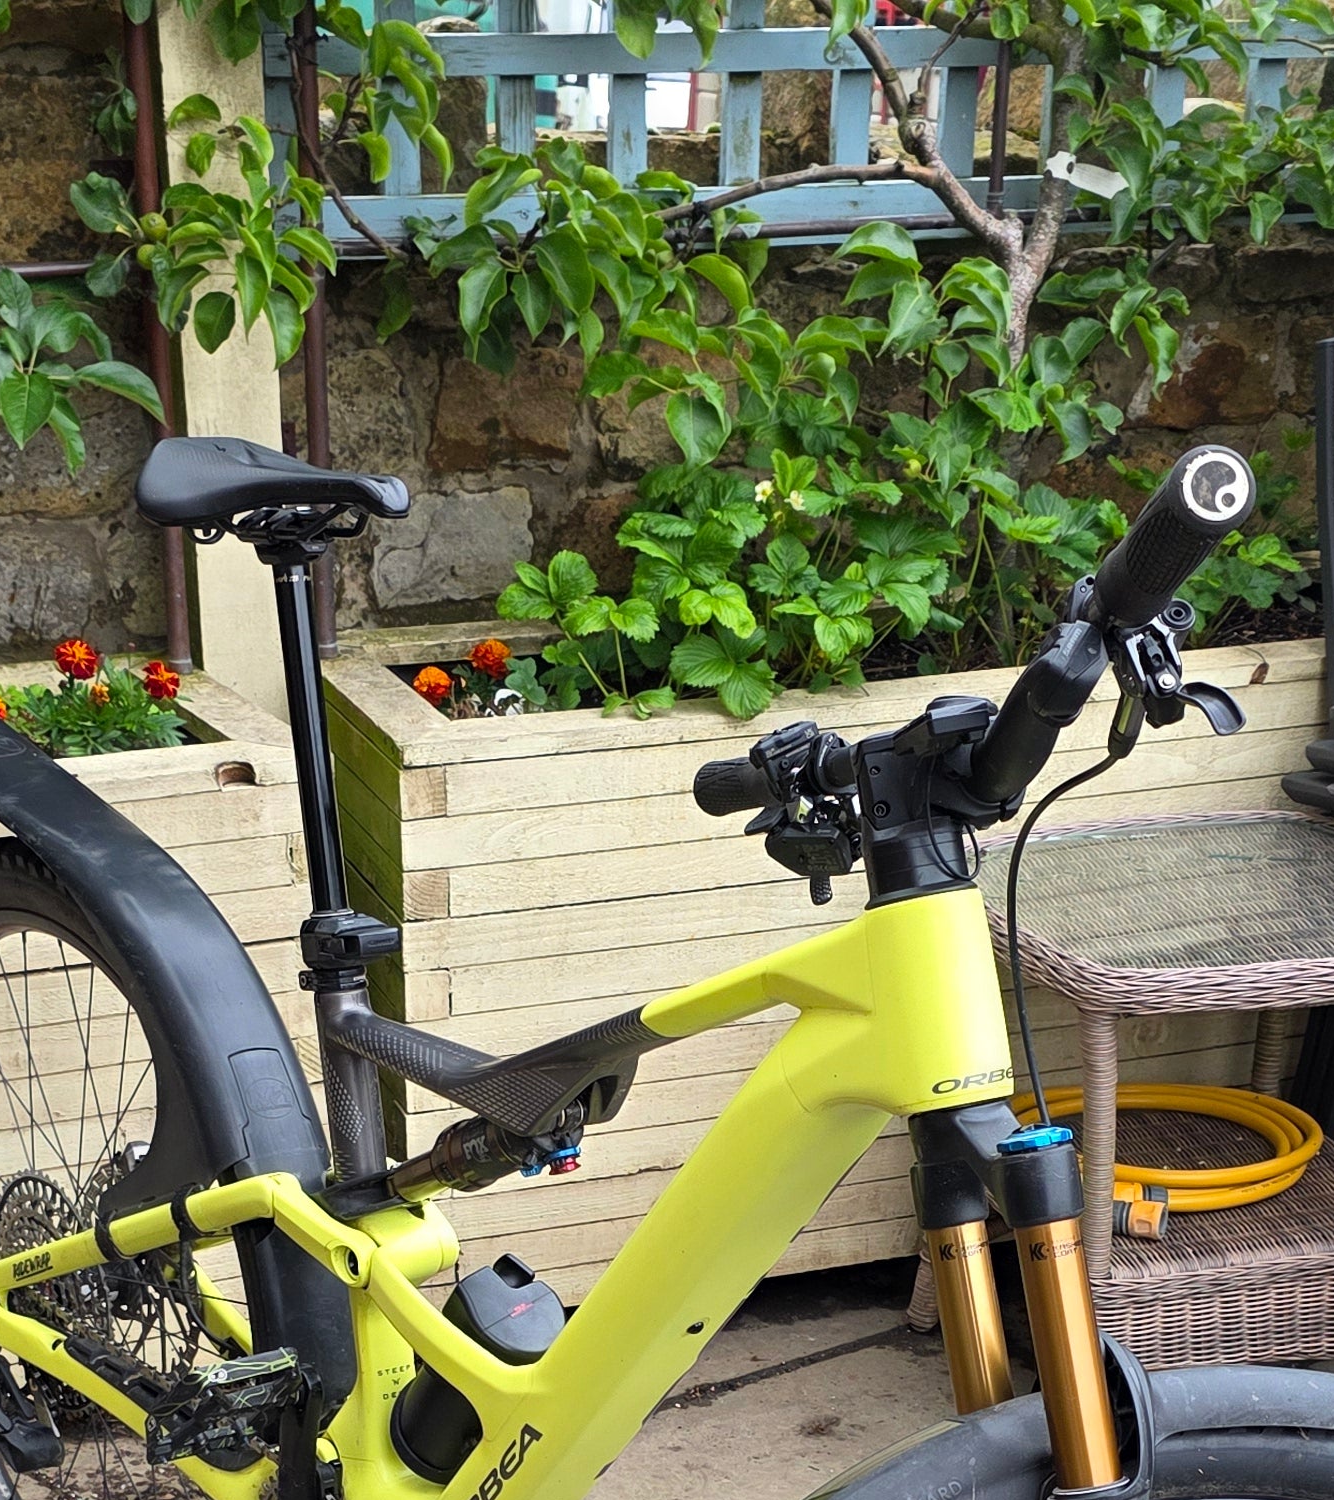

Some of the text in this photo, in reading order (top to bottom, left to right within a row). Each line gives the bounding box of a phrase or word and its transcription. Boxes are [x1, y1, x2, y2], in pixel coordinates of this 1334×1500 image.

[932, 1066, 1015, 1095] ORBE
[462, 1135, 490, 1161] FOX
[377, 1364, 410, 1377] STEEP
[382, 1391, 397, 1400] DE
